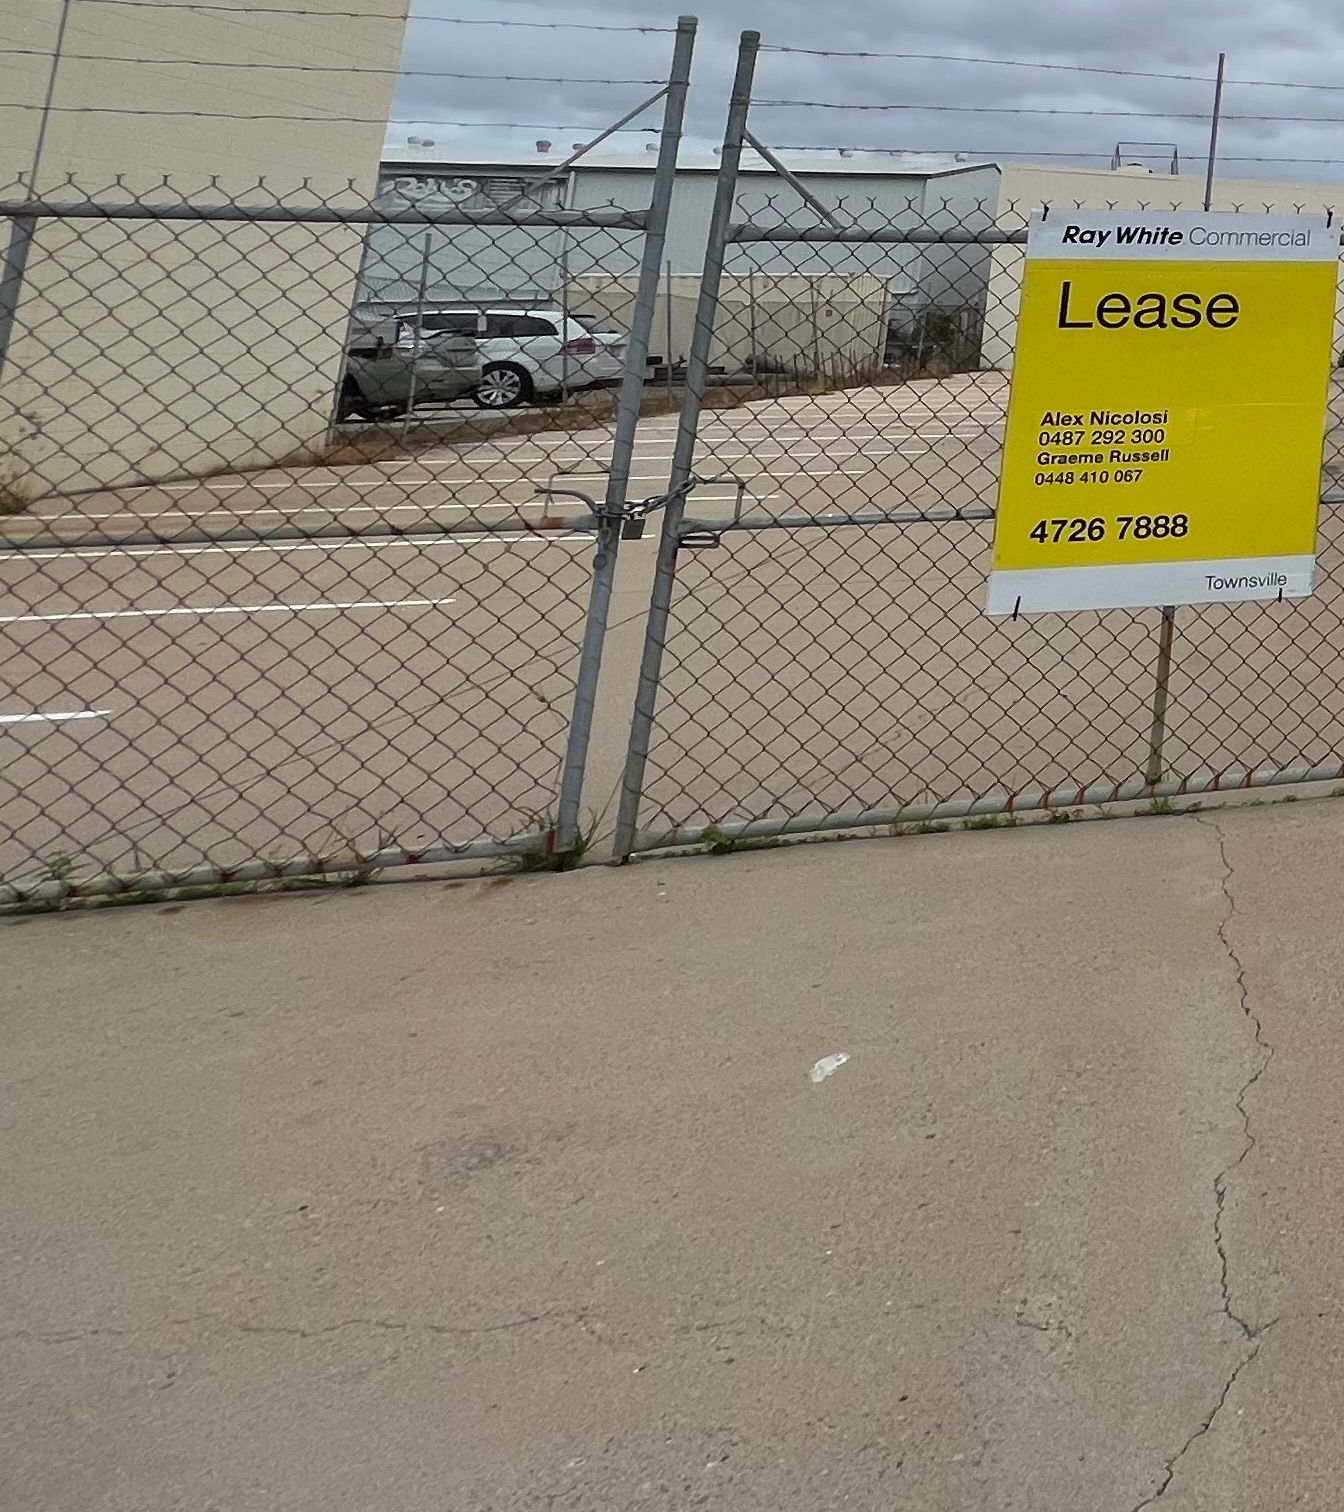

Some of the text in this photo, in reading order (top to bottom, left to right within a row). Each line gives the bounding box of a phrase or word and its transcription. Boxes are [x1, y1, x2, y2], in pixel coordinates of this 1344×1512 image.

[1062, 225, 1311, 248] Ray White Commercial
[1058, 281, 1240, 329] Lease
[1040, 409, 1168, 426] Alex Nicolosi
[1038, 429, 1165, 446] 0487 292 300
[1037, 449, 1169, 465] Graeme Russell
[1034, 469, 1143, 485] 0448 410 067
[1030, 514, 1188, 544] 4726 7888
[1205, 572, 1288, 589] Townsville
